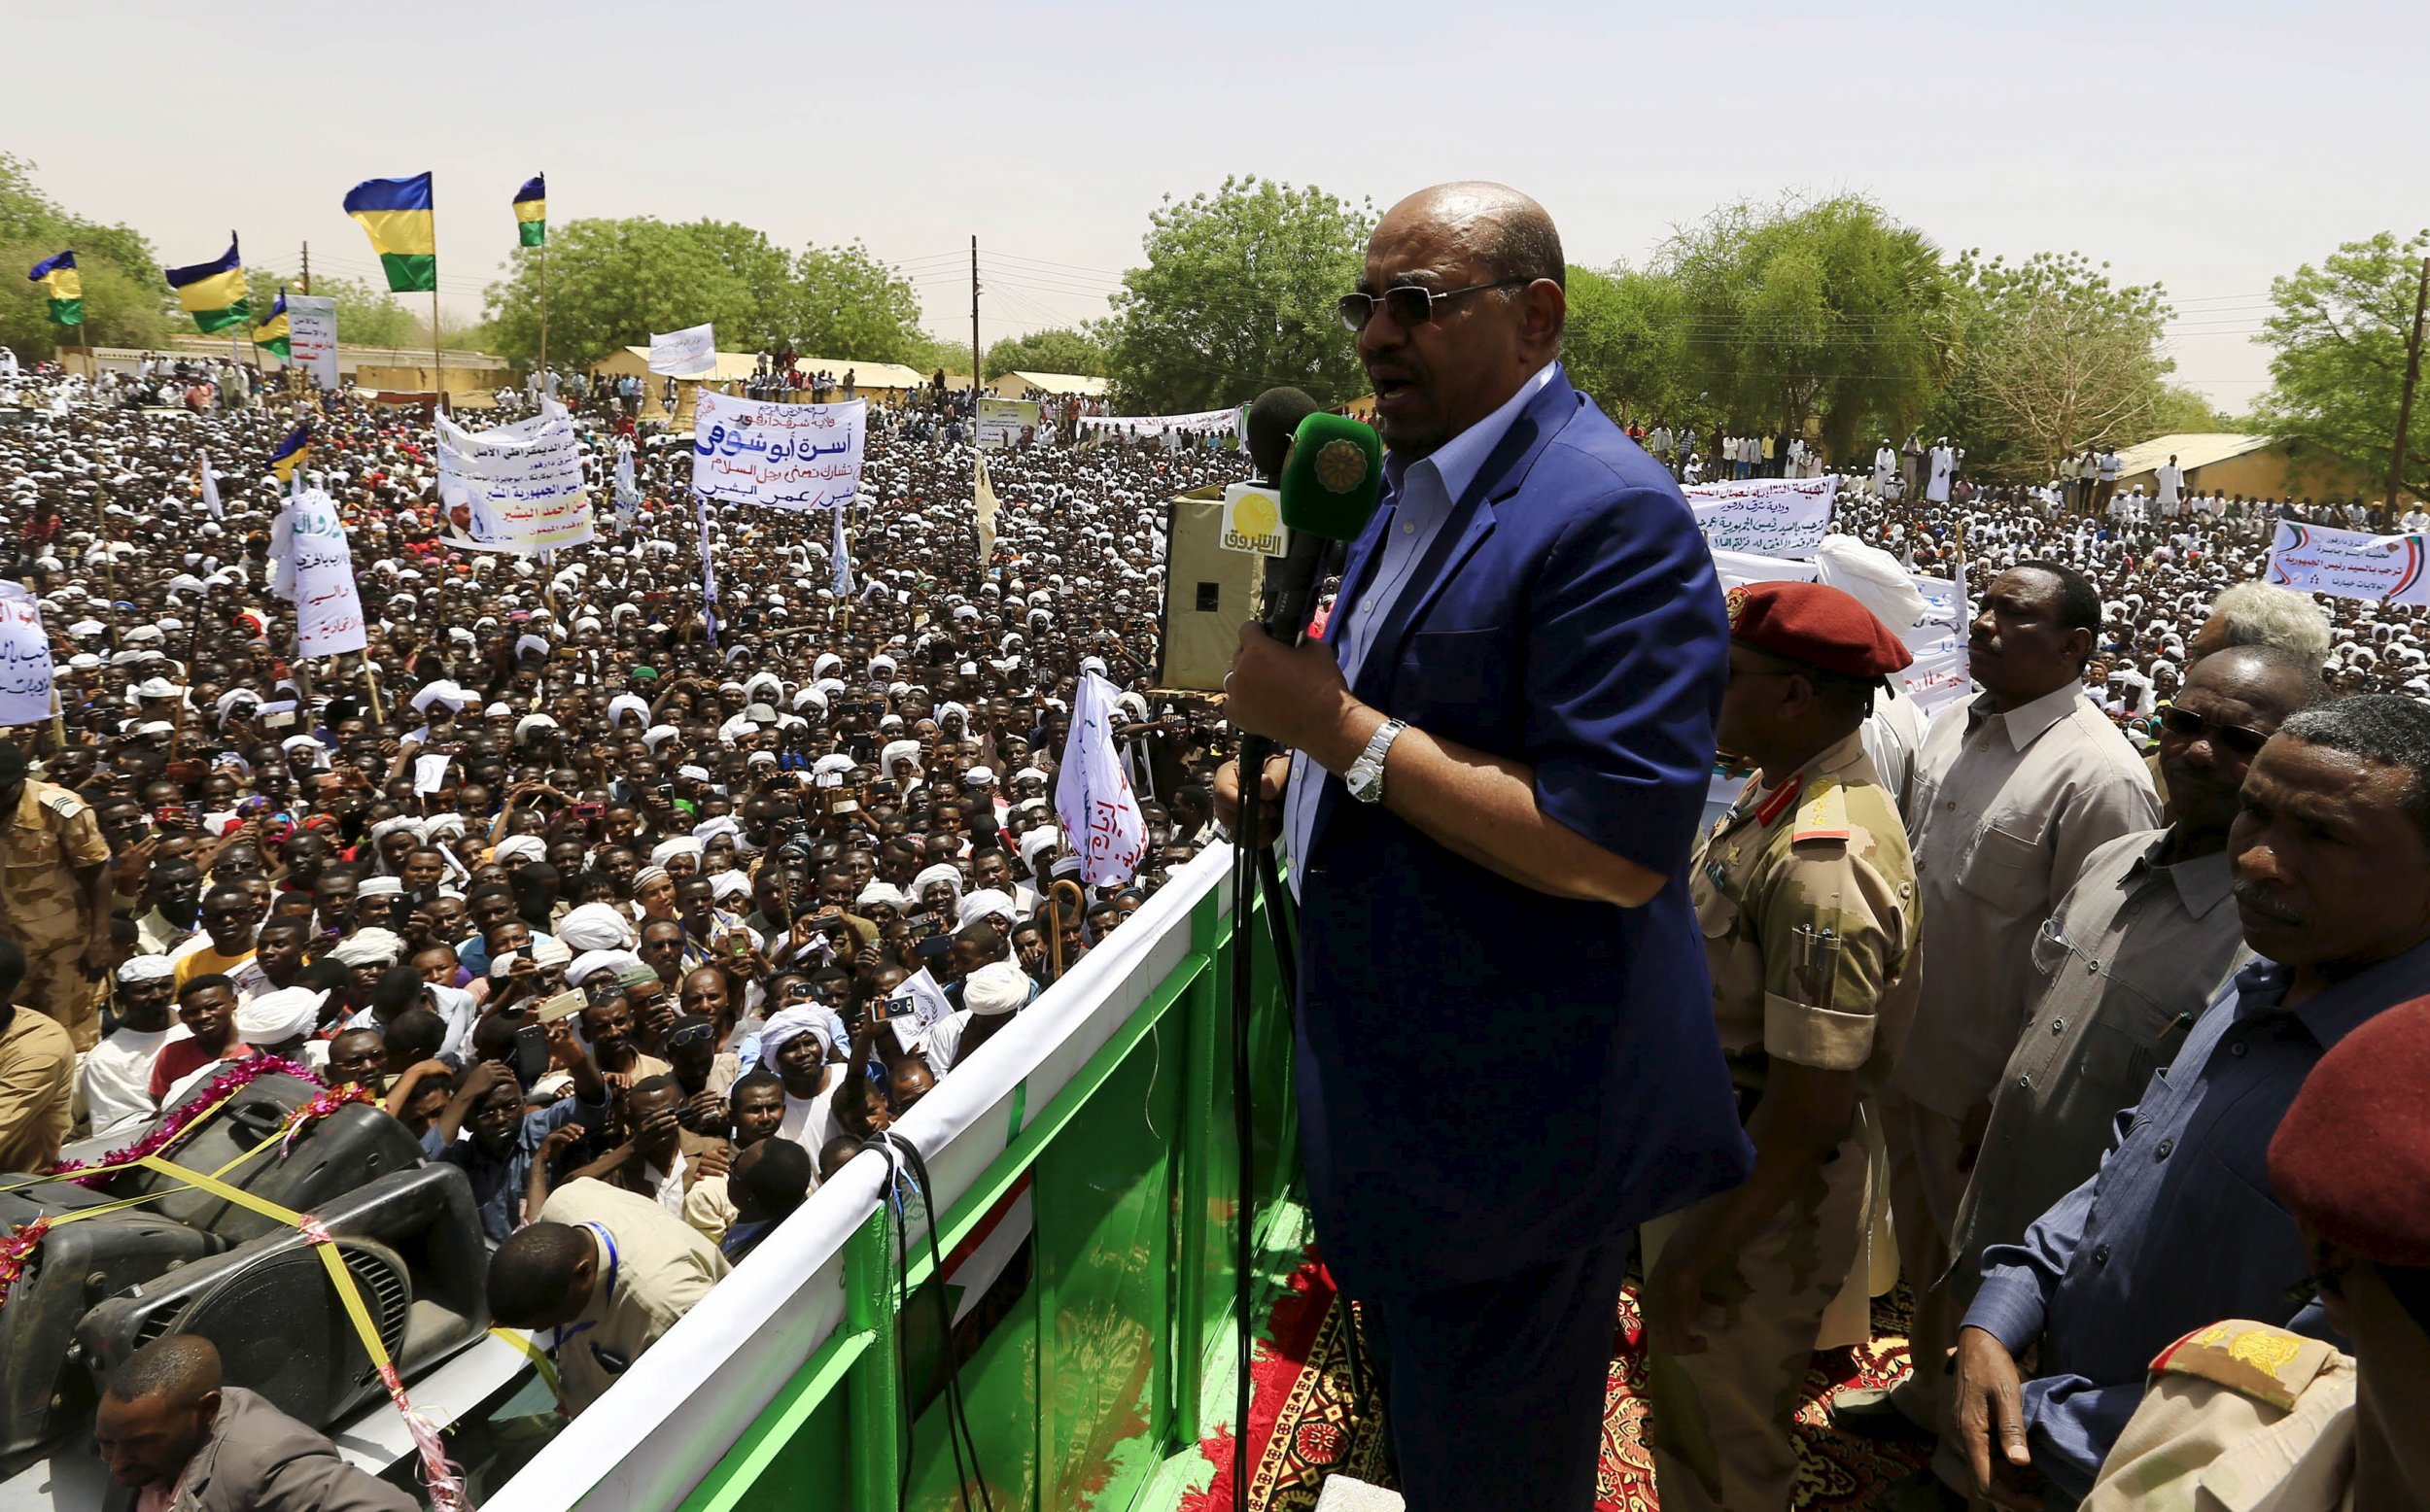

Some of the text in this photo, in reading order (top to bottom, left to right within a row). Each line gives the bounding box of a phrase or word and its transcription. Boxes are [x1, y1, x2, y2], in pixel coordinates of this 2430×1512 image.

[711, 458, 756, 476] السلام
[513, 484, 560, 501] الجمهورية
[696, 483, 757, 497] البشير
[760, 491, 810, 505] عمر
[502, 504, 538, 523] البشير
[1225, 529, 1282, 556] الشروق
[2285, 554, 2403, 575] ترحب بالسيد رئيس الجمهورية
